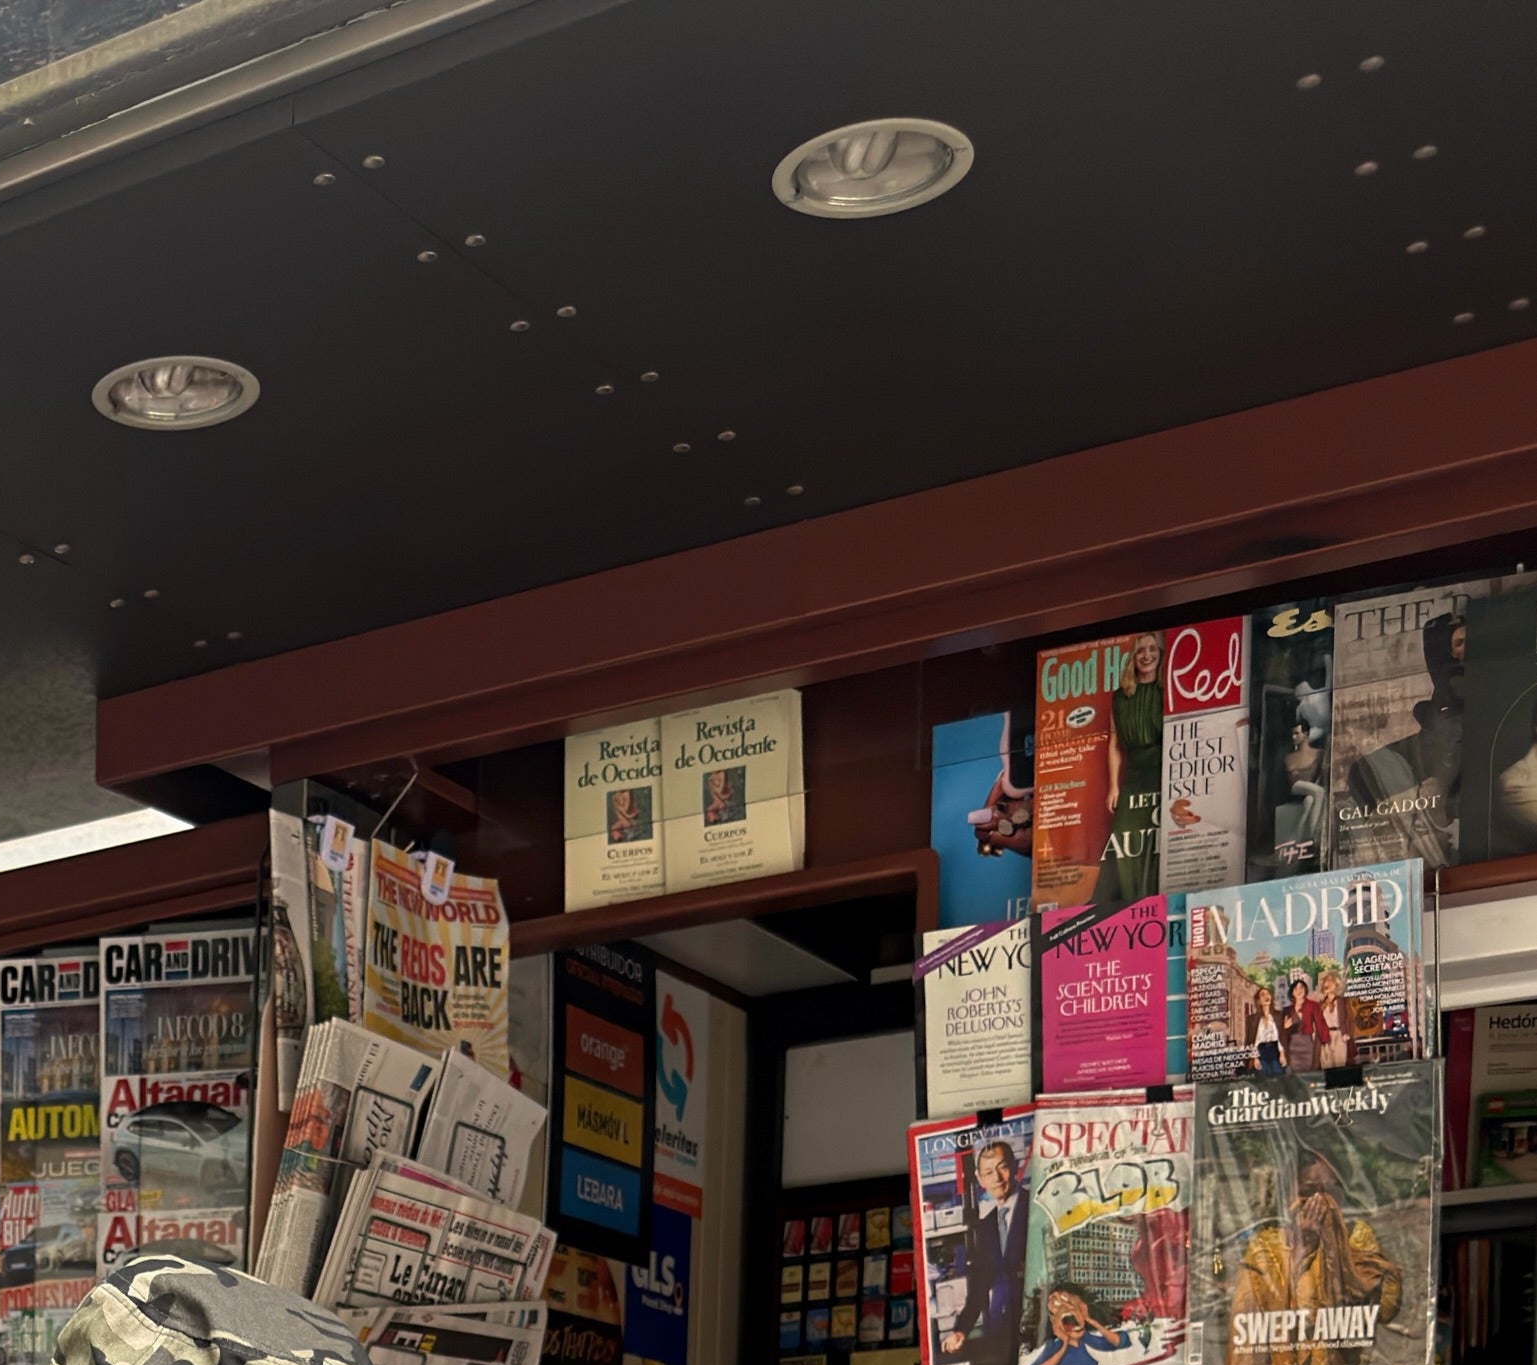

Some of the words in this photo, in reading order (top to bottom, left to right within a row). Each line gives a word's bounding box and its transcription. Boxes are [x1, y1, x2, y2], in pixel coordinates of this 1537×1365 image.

[1041, 650, 1098, 702] Good
[1167, 628, 1242, 712] Red
[695, 716, 756, 742] Revista
[1173, 721, 1204, 741] THE
[599, 736, 661, 761] Revista
[674, 748, 695, 769] de
[698, 735, 776, 766] Occidente
[1169, 737, 1225, 761] GUEST
[578, 764, 598, 788] de
[1169, 755, 1234, 781] EDITOR
[1169, 778, 1214, 799] ISSUE
[1340, 802, 1373, 820] GAL
[1377, 795, 1441, 817] GADOT
[704, 827, 747, 842] CUERPOS
[607, 847, 652, 860] CUERPOS
[1130, 904, 1159, 919] THE
[1206, 879, 1403, 946] MADRID
[105, 942, 162, 985] CAR
[373, 921, 398, 971] THE
[400, 934, 446, 987] REDS
[455, 946, 501, 988] ARE
[1367, 952, 1403, 965] AGENDA
[1086, 961, 1121, 978] THE
[0, 964, 55, 1005] CAR
[962, 986, 1007, 1002] JOHN
[1057, 974, 1152, 1000] SCIENTIST'S
[401, 981, 451, 1030] BACK
[947, 999, 1022, 1021] ROBERTS'S
[1060, 993, 1148, 1016] CHILDREN
[946, 1014, 1025, 1037] DELUSIONS
[581, 1033, 626, 1071] orange
[1227, 1087, 1270, 1106] The
[577, 1173, 623, 1212] LEBARA
[1233, 1309, 1308, 1345] SWEPT
[1314, 1305, 1380, 1341] AWAY
